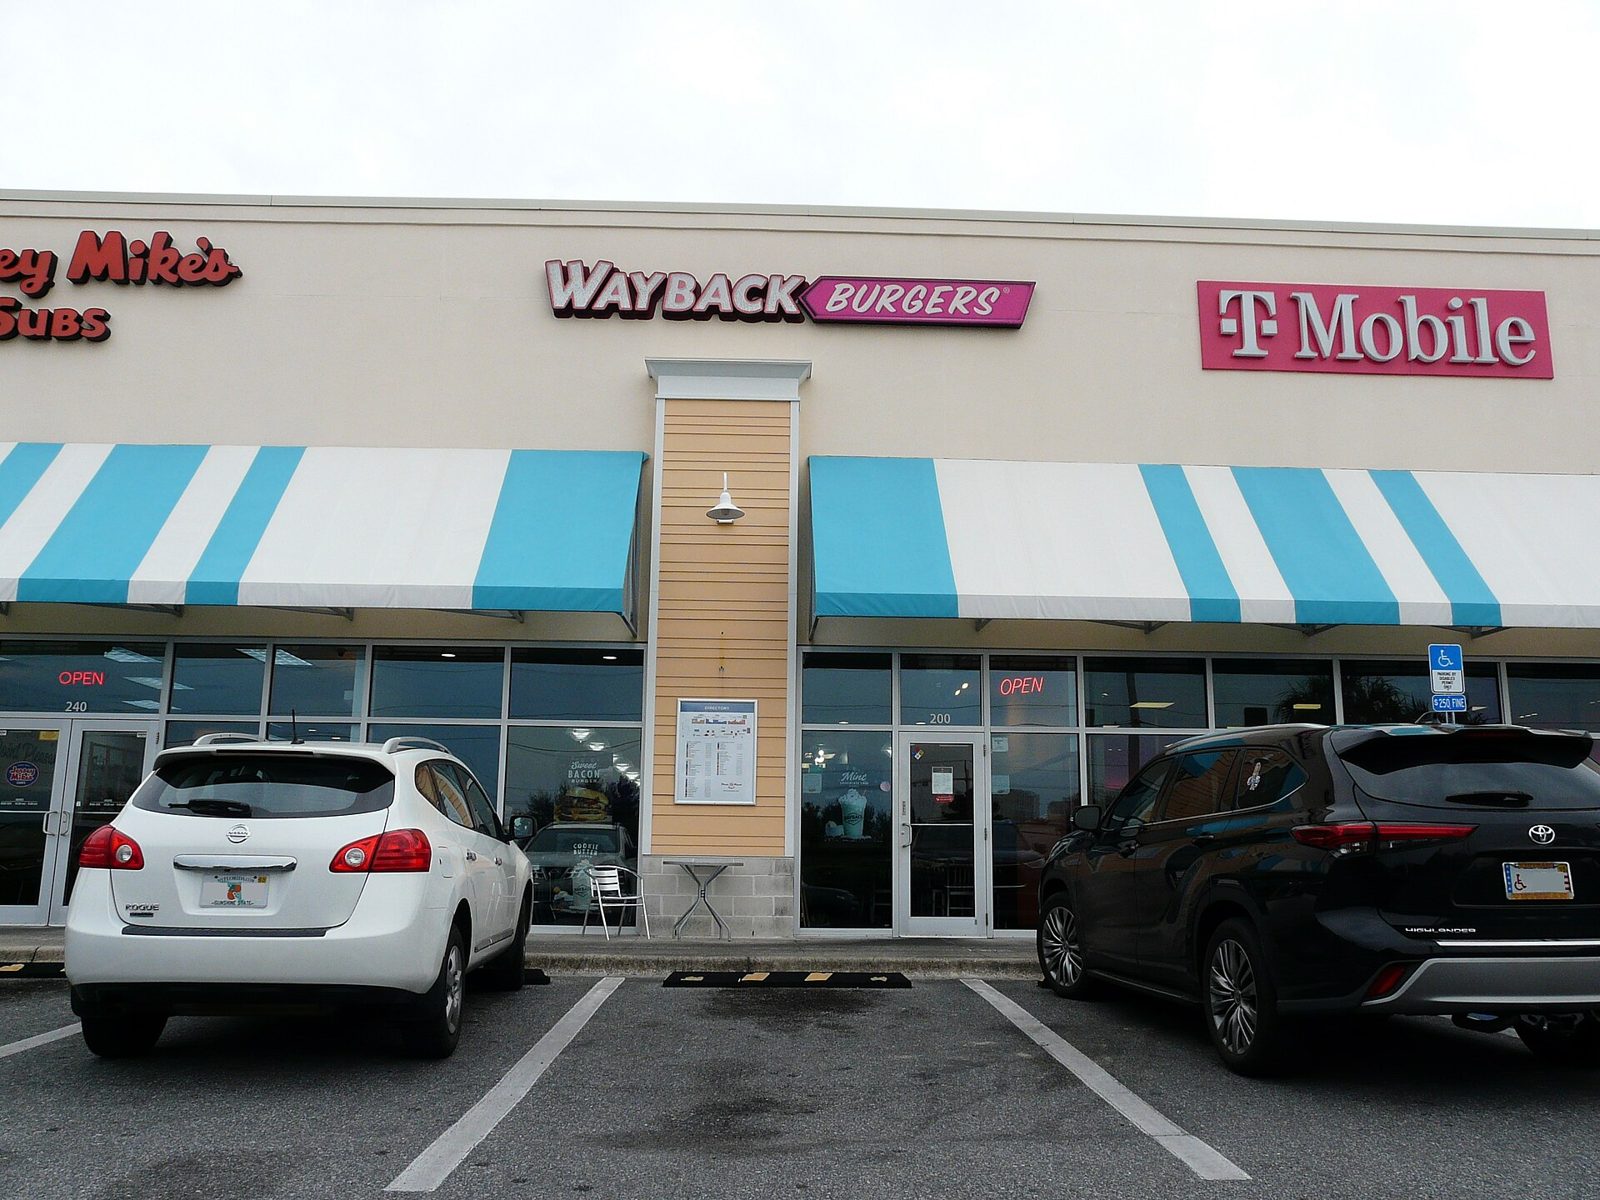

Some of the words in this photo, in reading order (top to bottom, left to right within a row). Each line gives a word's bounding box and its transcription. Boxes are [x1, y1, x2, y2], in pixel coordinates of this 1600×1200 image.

[66, 230, 243, 288] Mike's
[544, 258, 810, 323] WAYBACK
[58, 671, 105, 686] OPEN
[1000, 676, 1044, 696] OPEN
[65, 701, 88, 712] 240
[1434, 698, 1451, 708] $250
[1452, 698, 1465, 708] FINE
[929, 713, 951, 724] 200
[571, 760, 597, 770] Sweet
[567, 769, 600, 779] BACON
[840, 771, 868, 782] Mint
[125, 903, 160, 911] ROGUE
